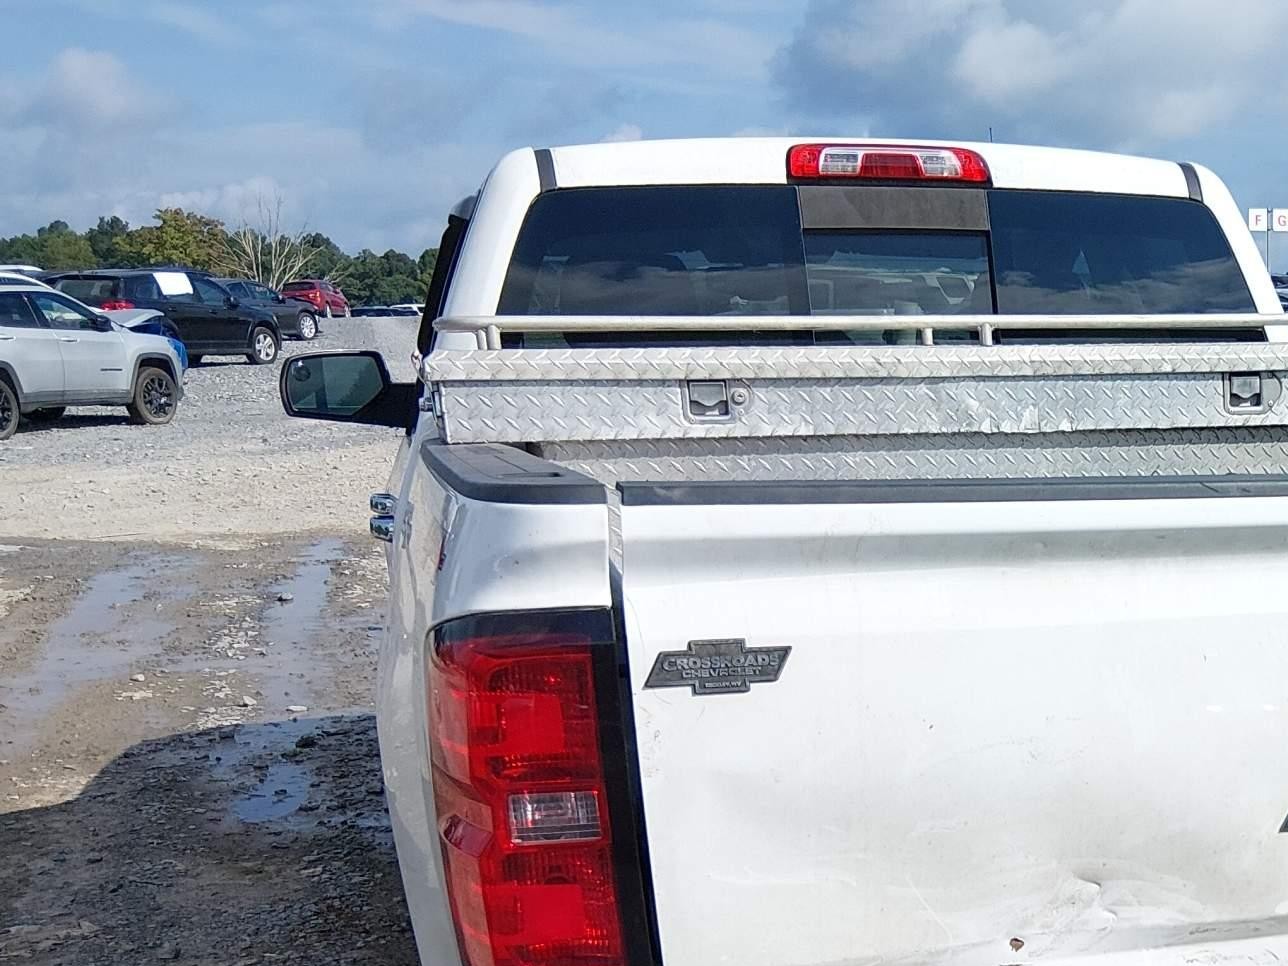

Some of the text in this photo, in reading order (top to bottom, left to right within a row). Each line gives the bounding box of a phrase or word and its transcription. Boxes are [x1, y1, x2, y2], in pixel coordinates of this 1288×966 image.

[1255, 214, 1263, 226] F
[1277, 214, 1287, 227] G
[662, 653, 780, 671] CROSSROADS
[682, 667, 762, 678] CHEVROLET
